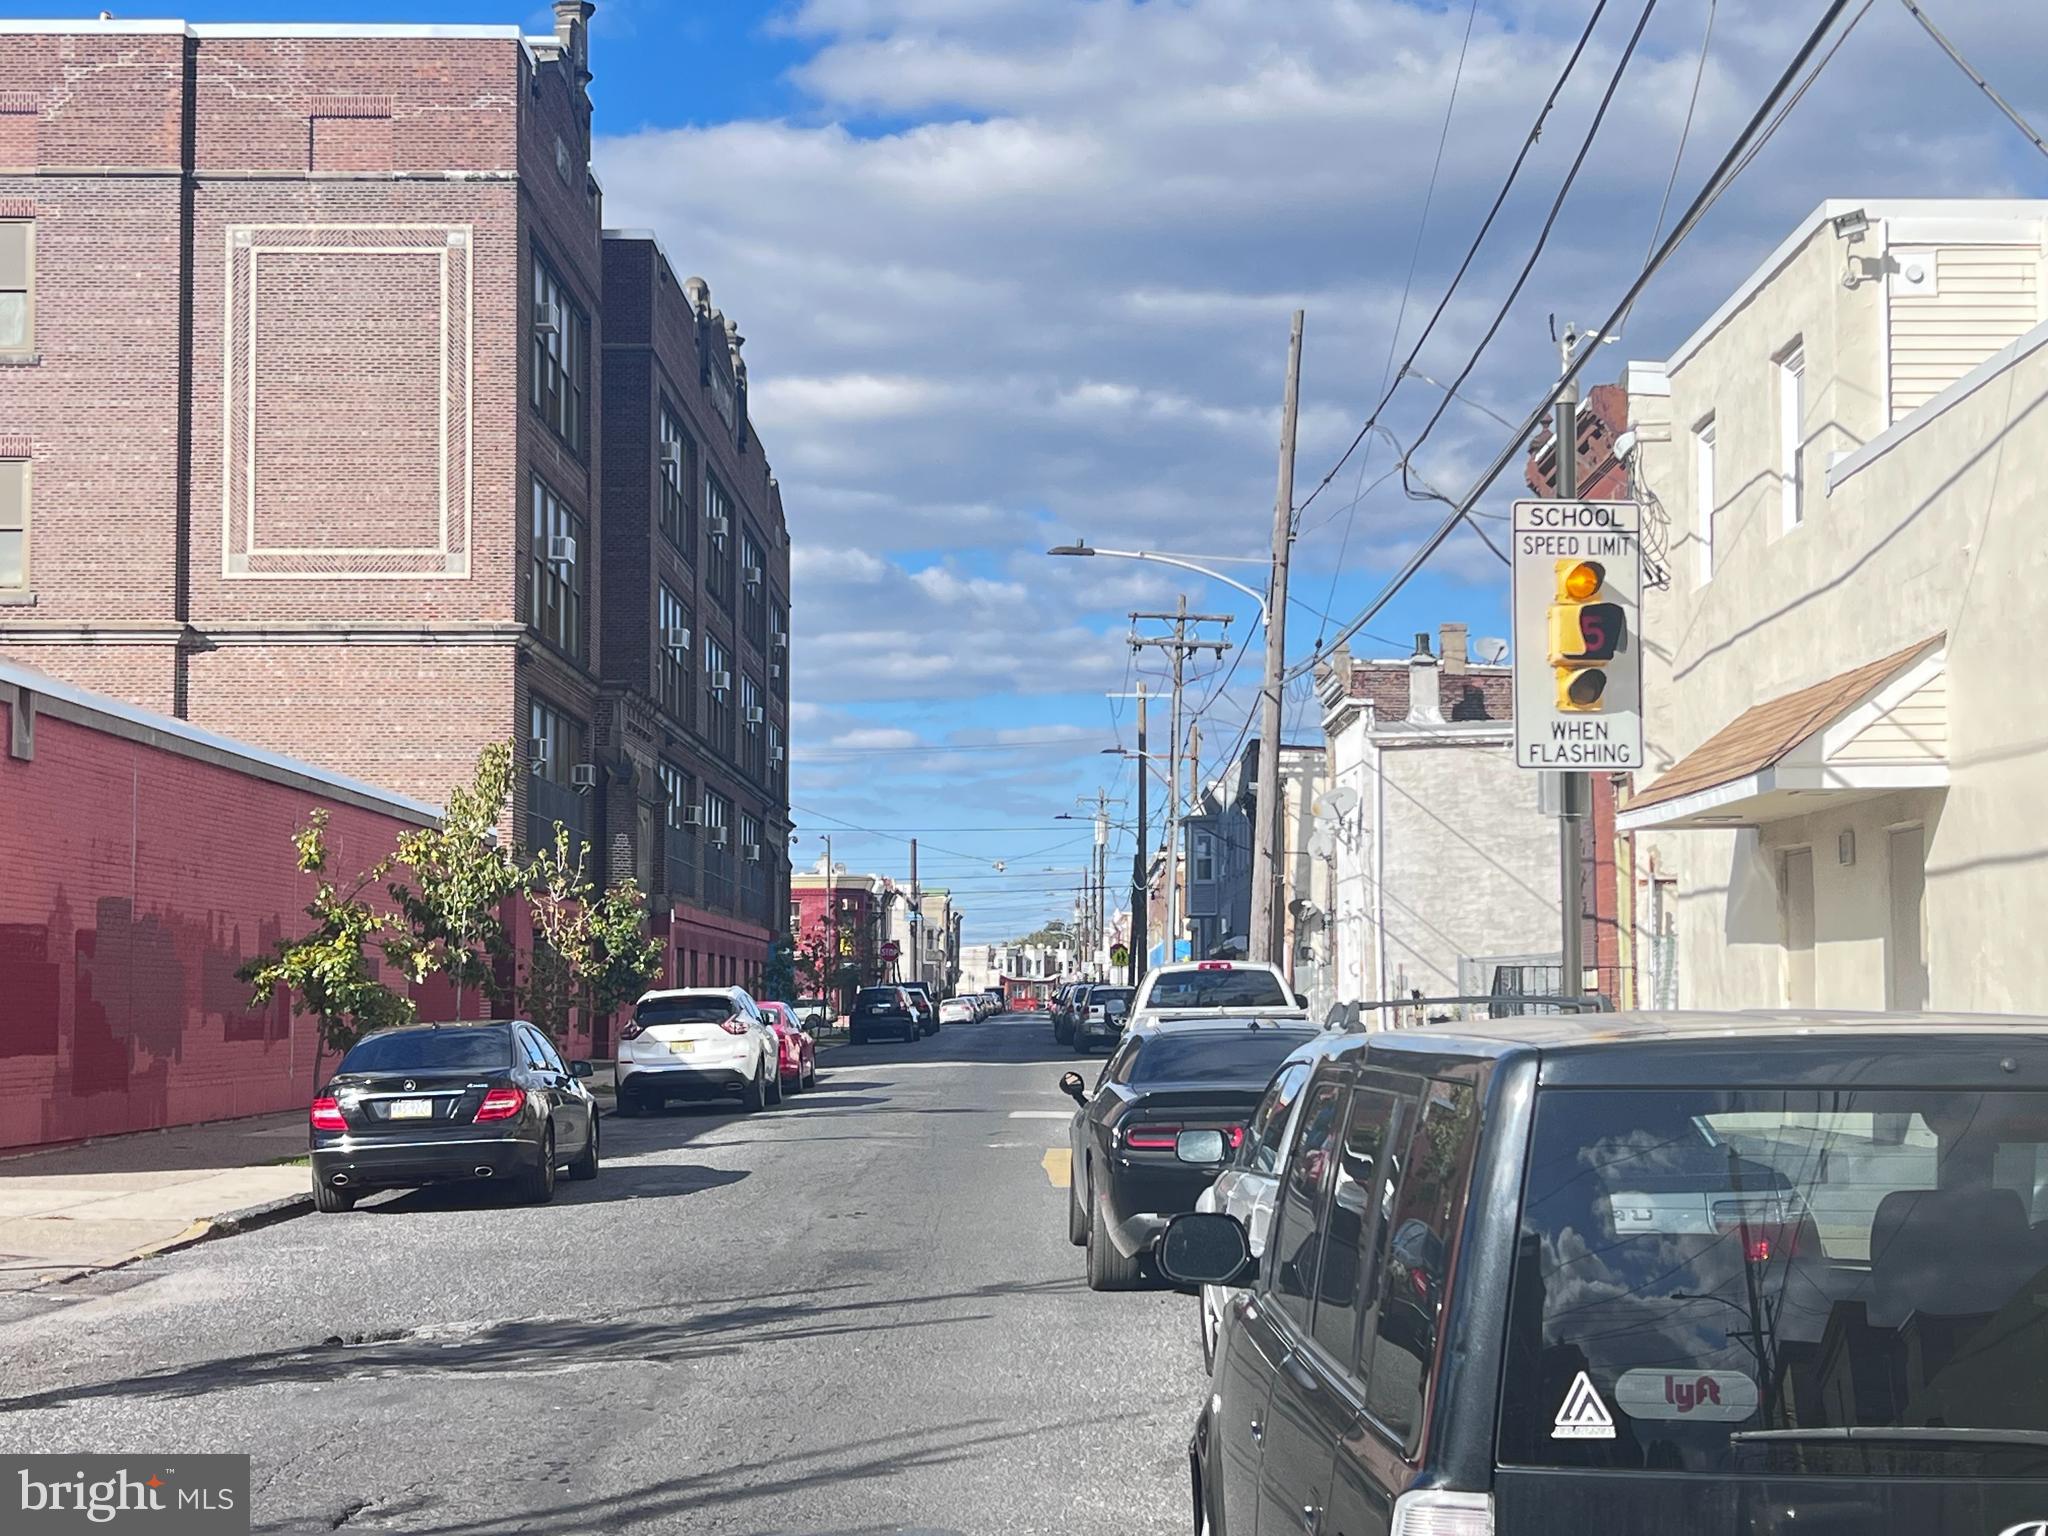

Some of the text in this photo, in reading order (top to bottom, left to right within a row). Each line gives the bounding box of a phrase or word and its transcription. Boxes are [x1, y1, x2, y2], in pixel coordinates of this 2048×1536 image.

[1530, 508, 1624, 527] SCHOOL
[1523, 536, 1631, 556] SPEED LIMIT
[1551, 721, 1609, 741] WHEN
[1529, 744, 1631, 763] FLASHING
[1664, 1375, 1721, 1413] lyft
